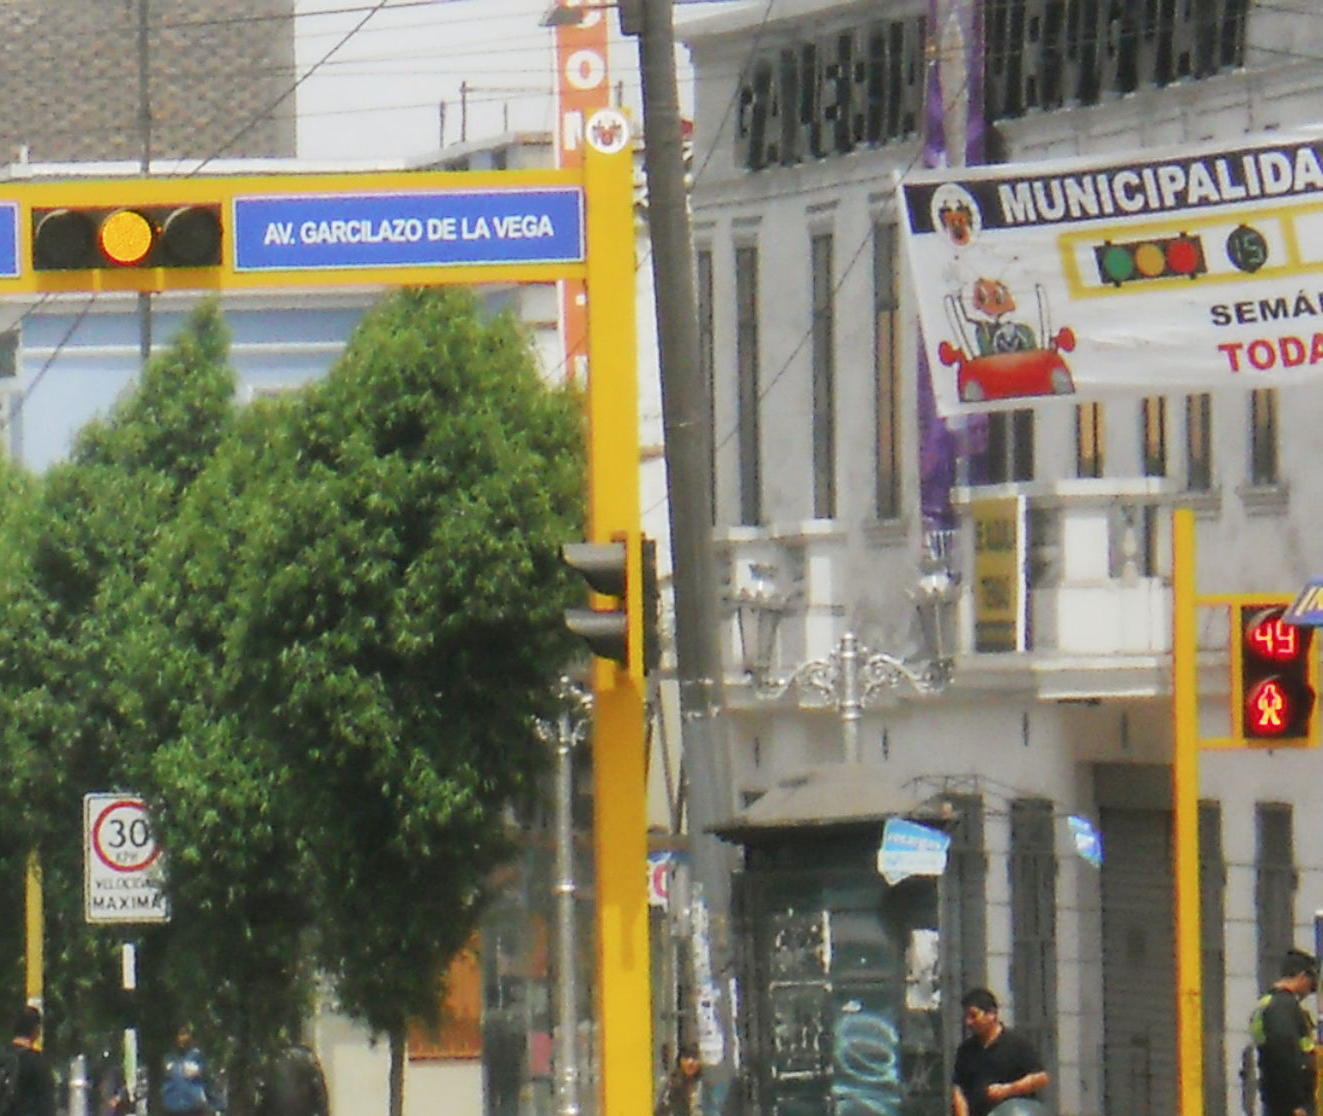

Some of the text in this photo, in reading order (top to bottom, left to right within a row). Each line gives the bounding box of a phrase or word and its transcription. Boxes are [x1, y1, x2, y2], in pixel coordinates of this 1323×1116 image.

[264, 215, 554, 245] AV. GARCILAZO DE LA VEGA
[1211, 289, 1323, 326] SEMÁ
[1255, 619, 1294, 653] 49
[108, 819, 149, 848] 30
